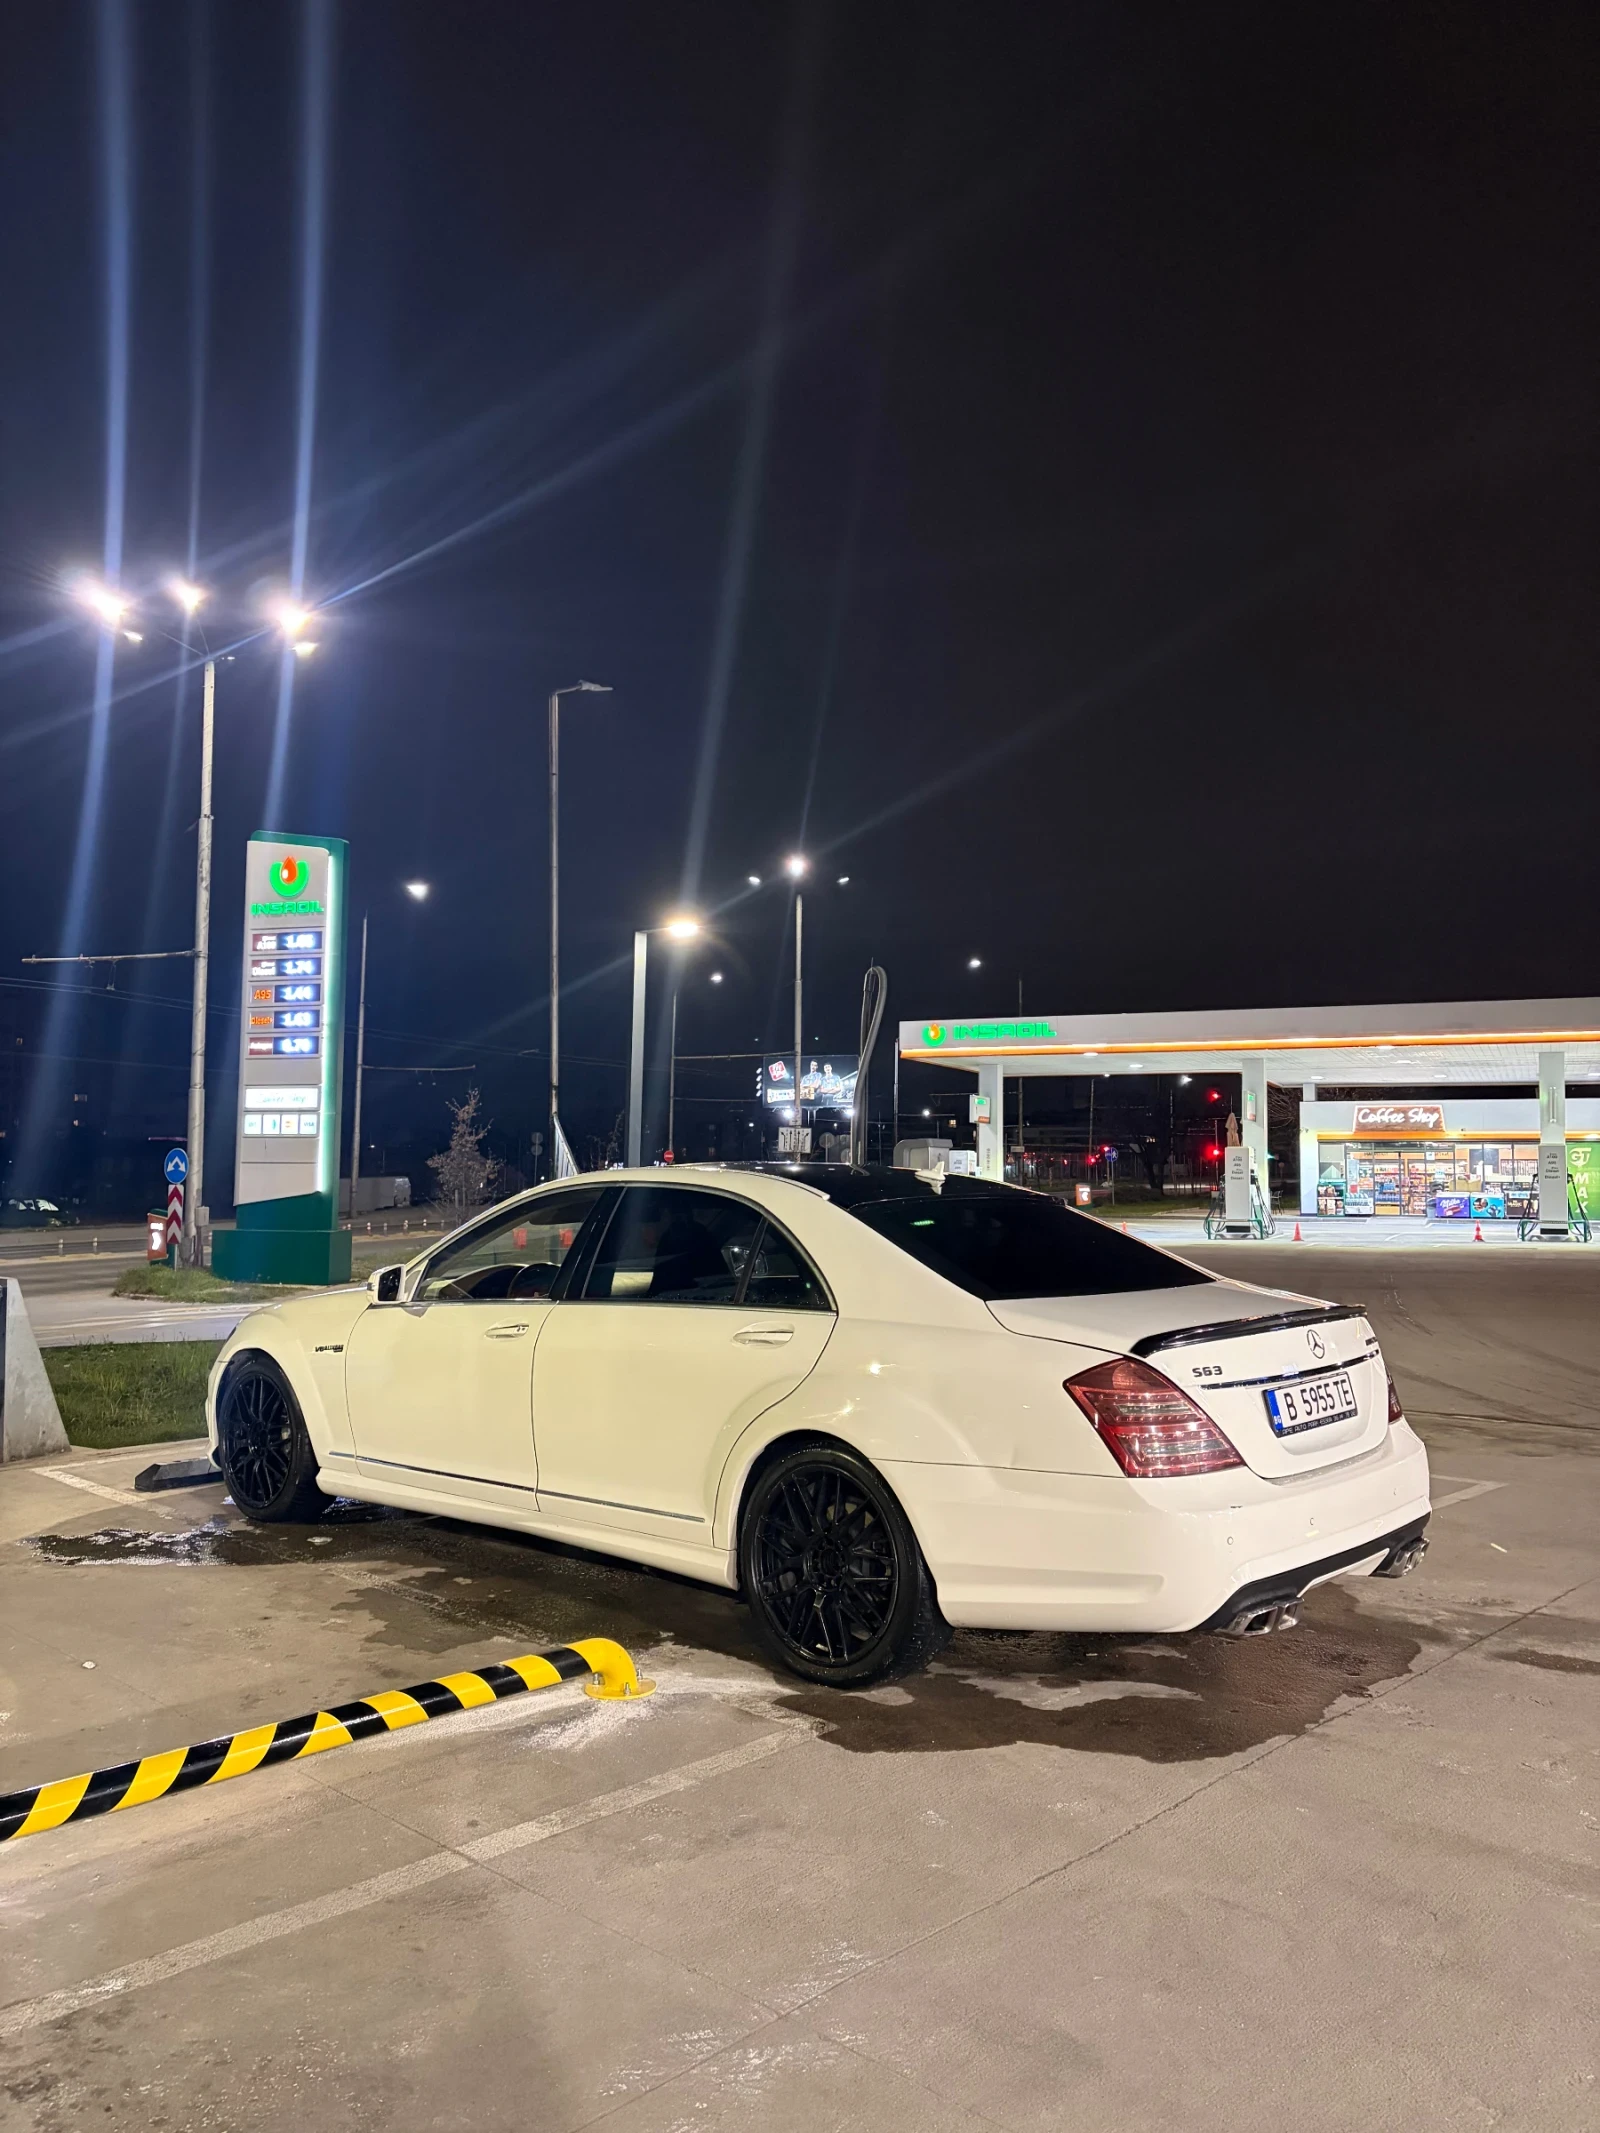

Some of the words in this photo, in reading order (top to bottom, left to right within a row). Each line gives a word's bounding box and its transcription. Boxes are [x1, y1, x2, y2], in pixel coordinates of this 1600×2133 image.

[251, 901, 325, 915] INSAOIL
[254, 989, 272, 1000] A95
[953, 1022, 1058, 1040] INSAOIL
[1358, 1107, 1405, 1123] Coffee
[1408, 1107, 1440, 1128] Shop
[1192, 1365, 1223, 1378] S63
[1283, 1392, 1298, 1421] B
[1300, 1383, 1336, 1416] 5955
[1333, 1379, 1353, 1408] TE
